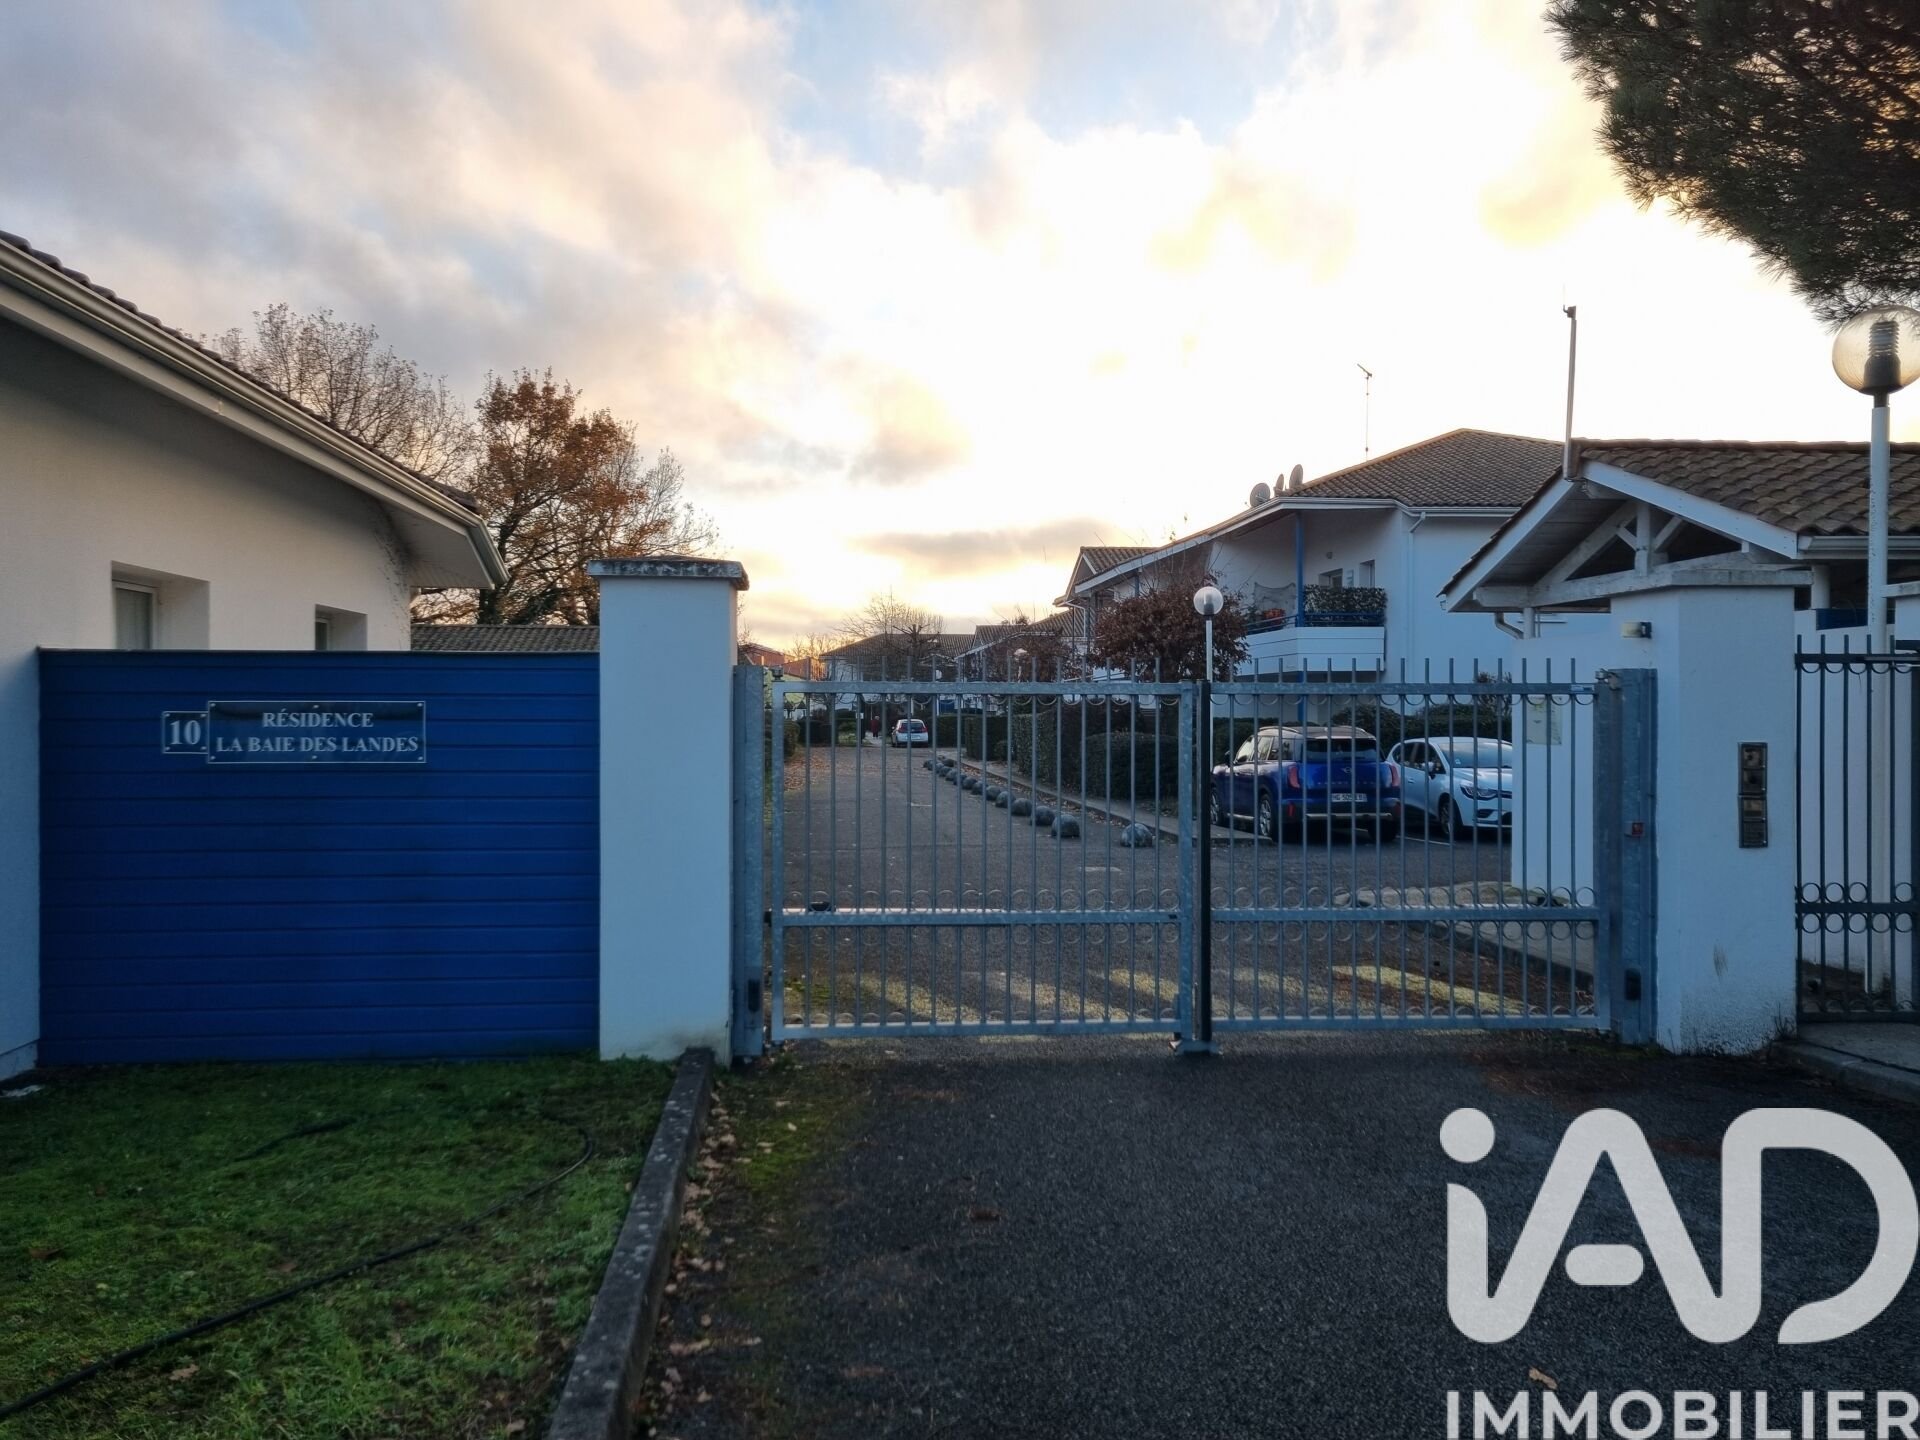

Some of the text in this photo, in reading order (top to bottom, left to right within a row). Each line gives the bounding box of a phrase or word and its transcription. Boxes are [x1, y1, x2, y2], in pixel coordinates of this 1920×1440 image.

[262, 708, 374, 728] RÉSIDENCE
[169, 719, 201, 746] 10
[216, 736, 419, 752] LA BAIE DES LANDES
